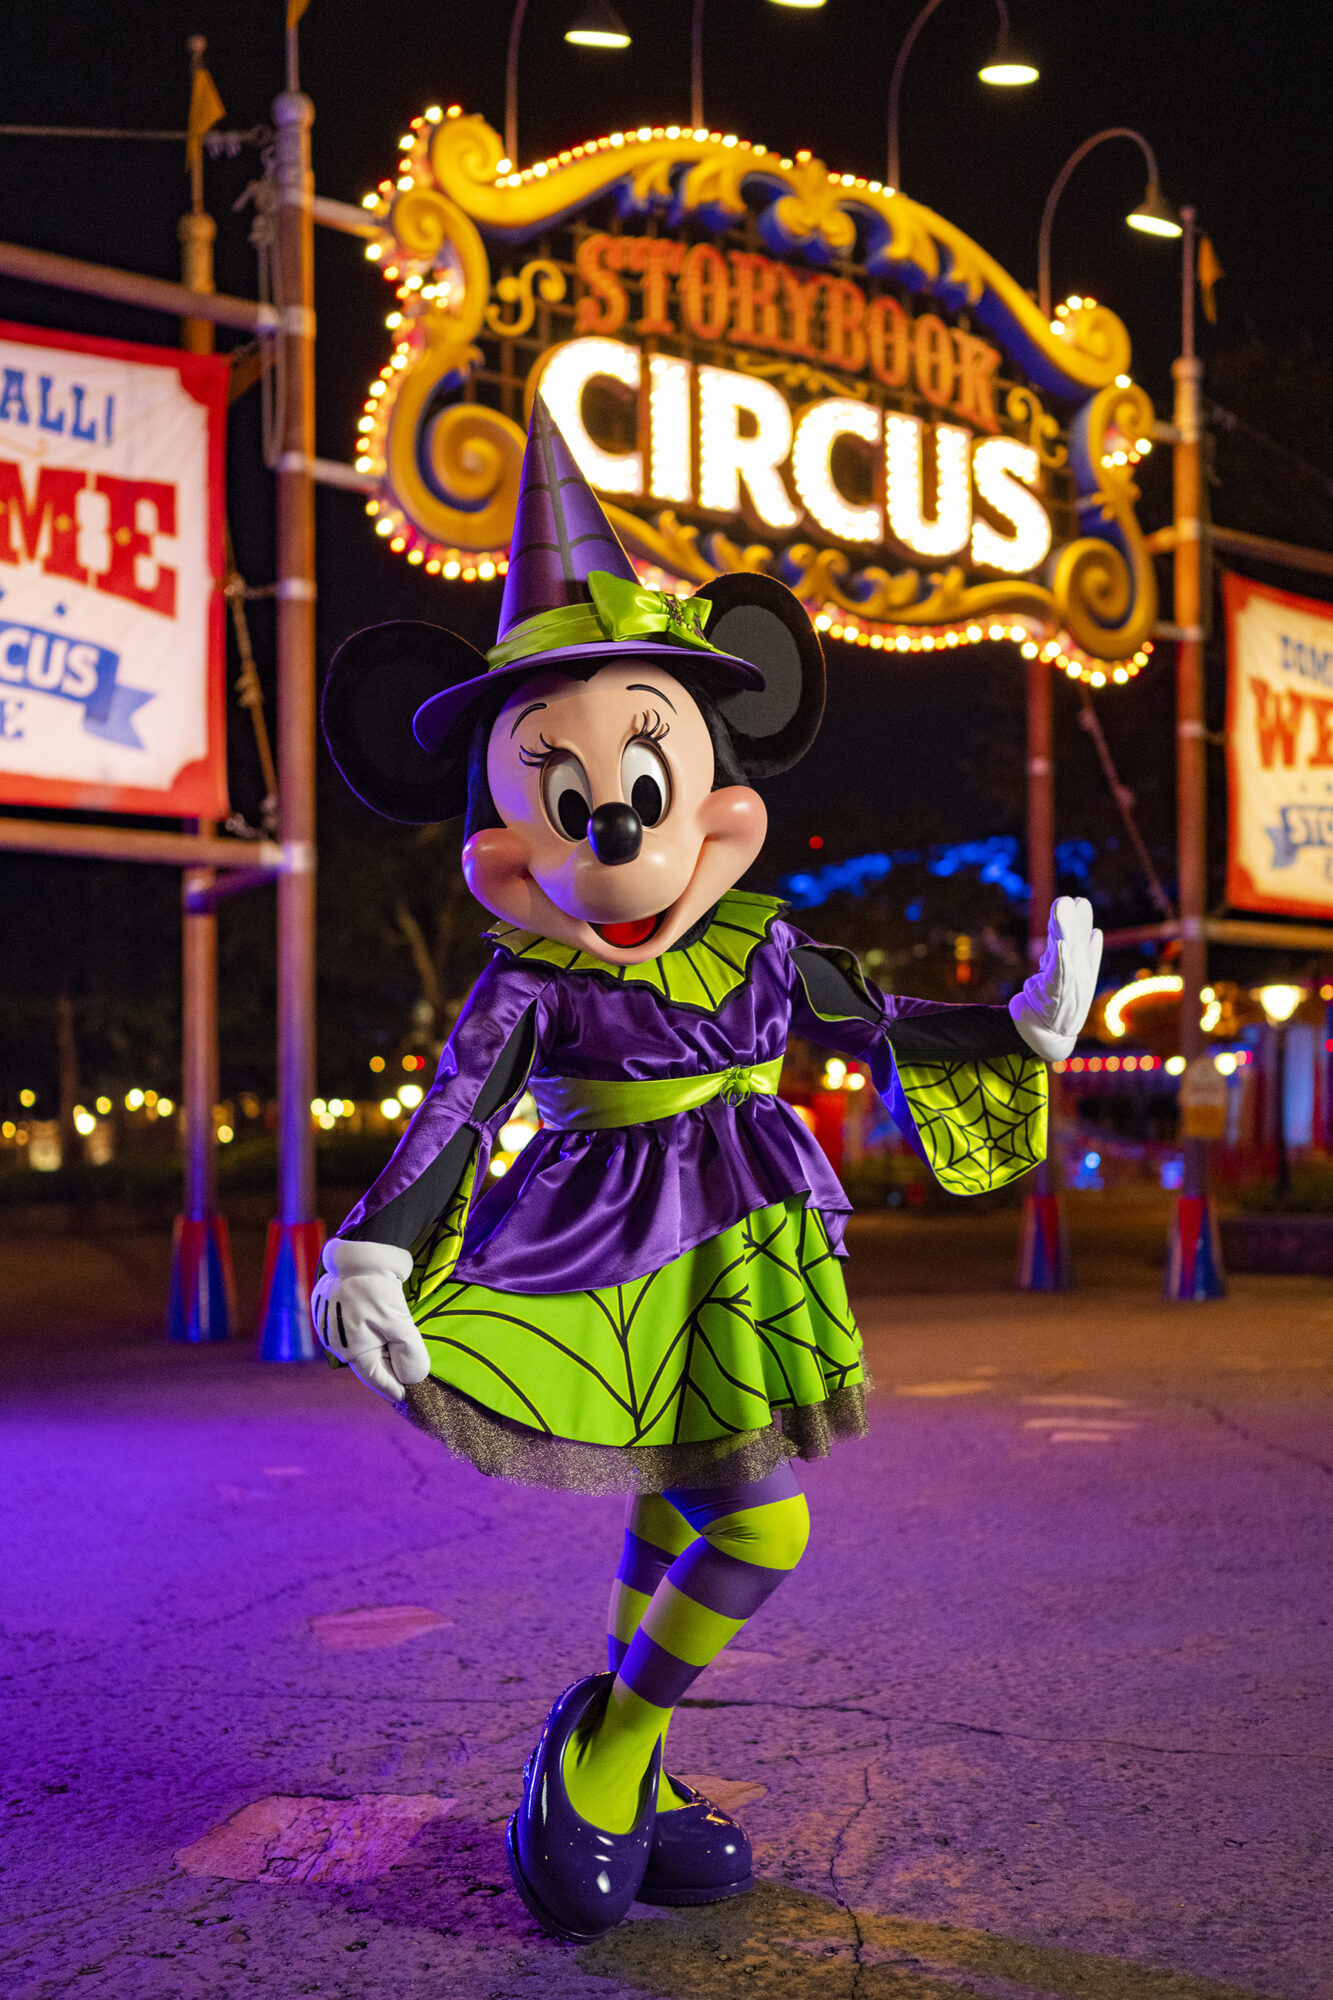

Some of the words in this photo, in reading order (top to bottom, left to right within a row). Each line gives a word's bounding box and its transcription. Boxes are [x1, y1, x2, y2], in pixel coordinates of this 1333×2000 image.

[0, 367, 114, 447] ALL!
[575, 233, 1000, 434] STORYBOOK
[534, 335, 1053, 575] CIRCUS
